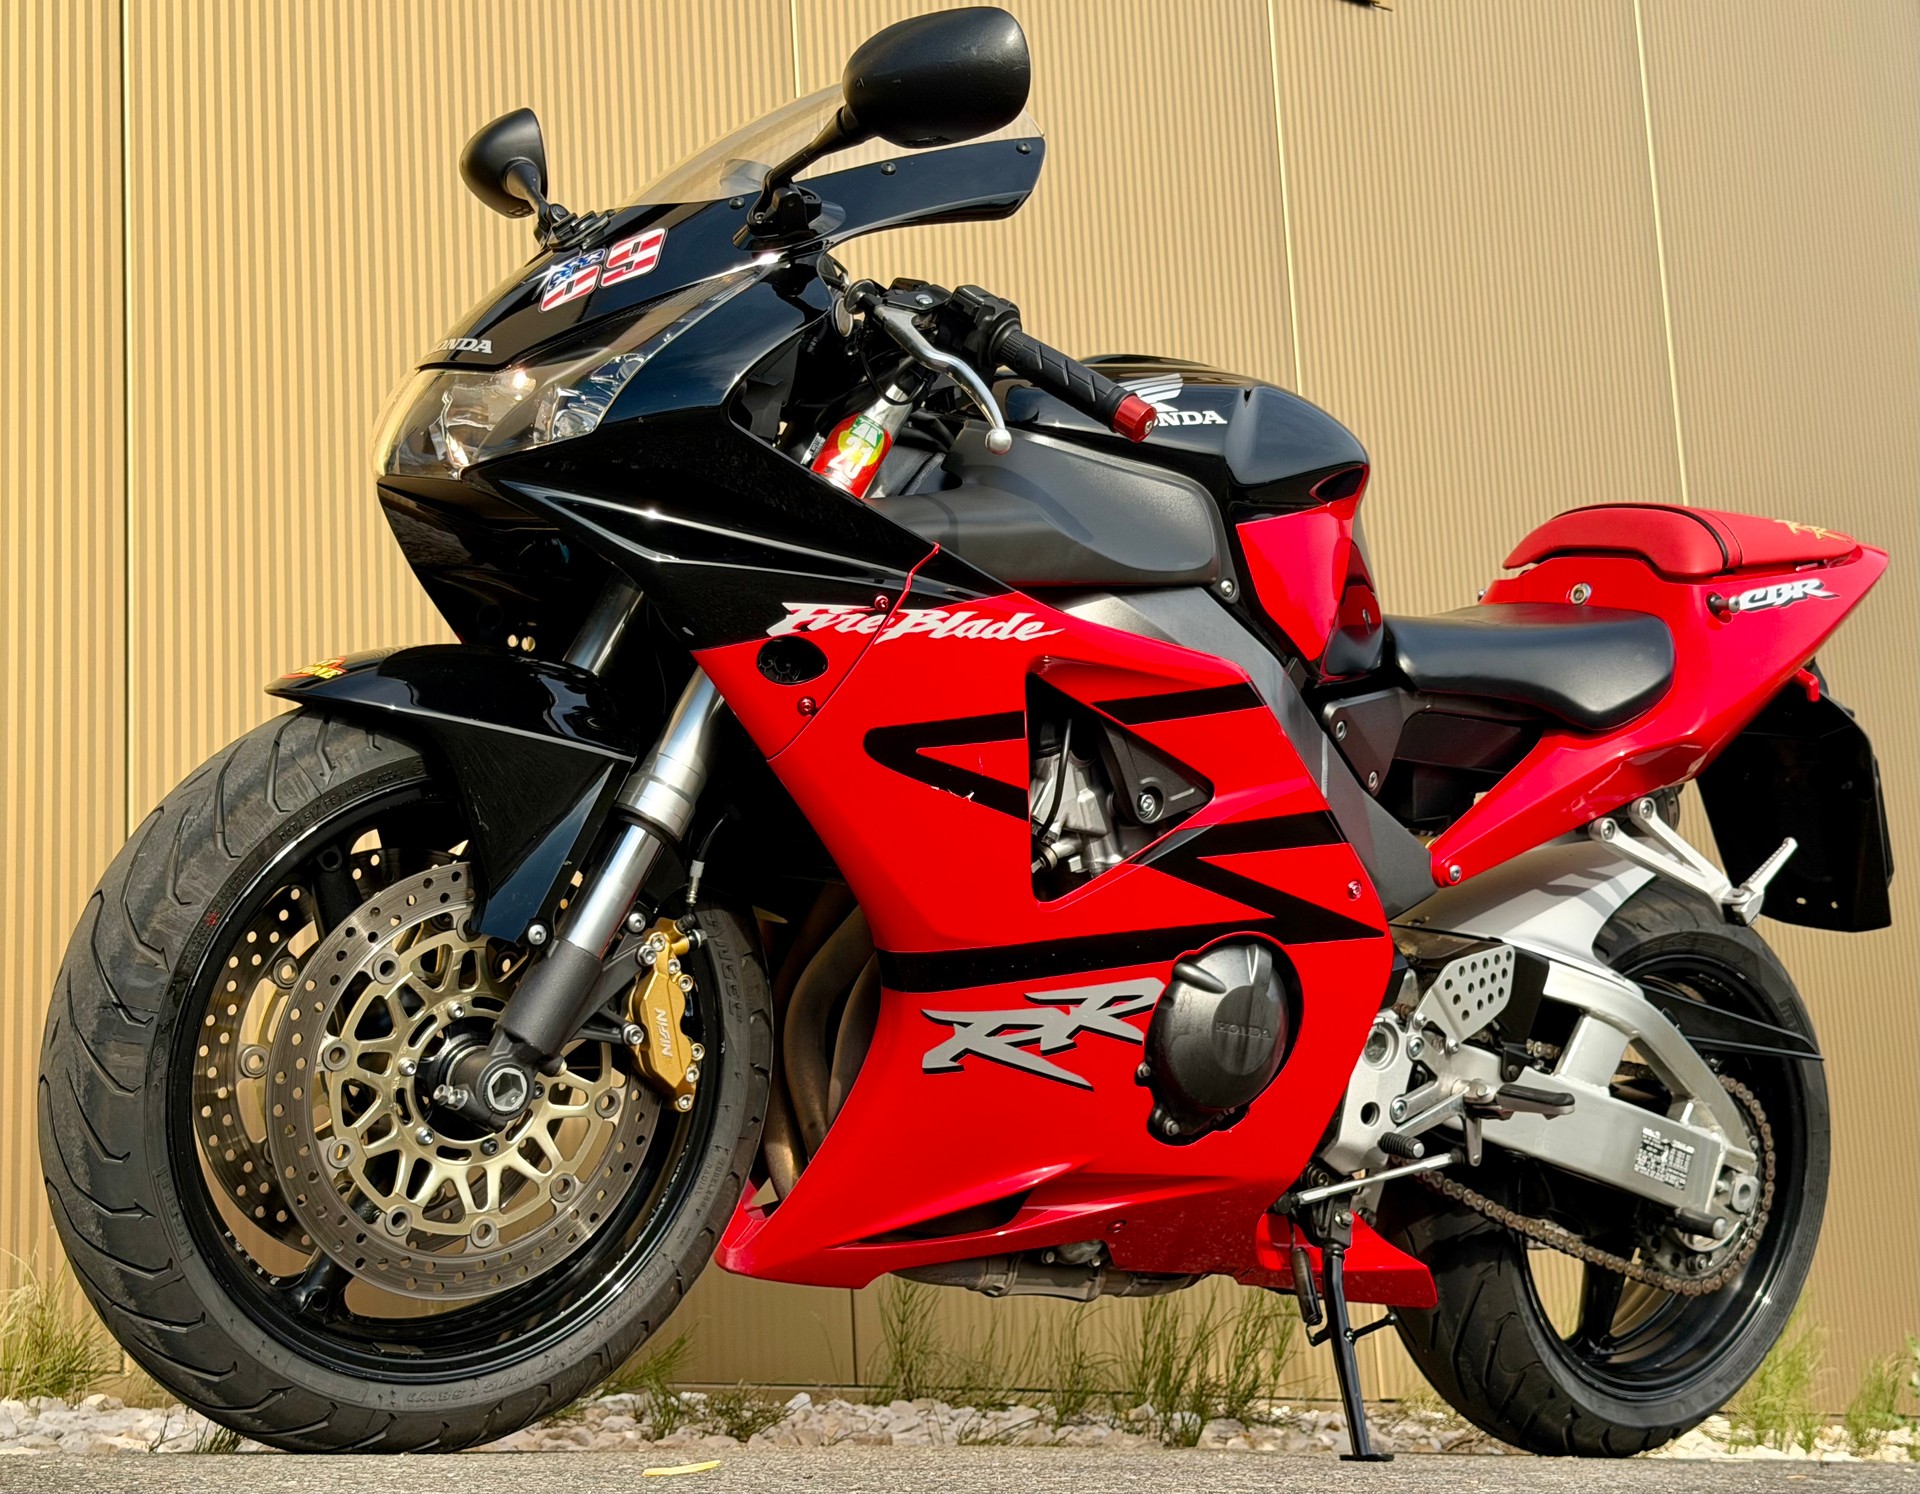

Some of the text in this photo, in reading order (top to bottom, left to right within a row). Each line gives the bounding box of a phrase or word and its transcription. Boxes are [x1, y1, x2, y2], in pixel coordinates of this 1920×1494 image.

[435, 337, 493, 354] ONDA
[1153, 410, 1228, 427] NDA
[1739, 578, 1840, 612] CBR
[654, 1007, 673, 1057] NISSIN
[921, 977, 1166, 1092] RR
[1214, 1018, 1272, 1040] HONDA
